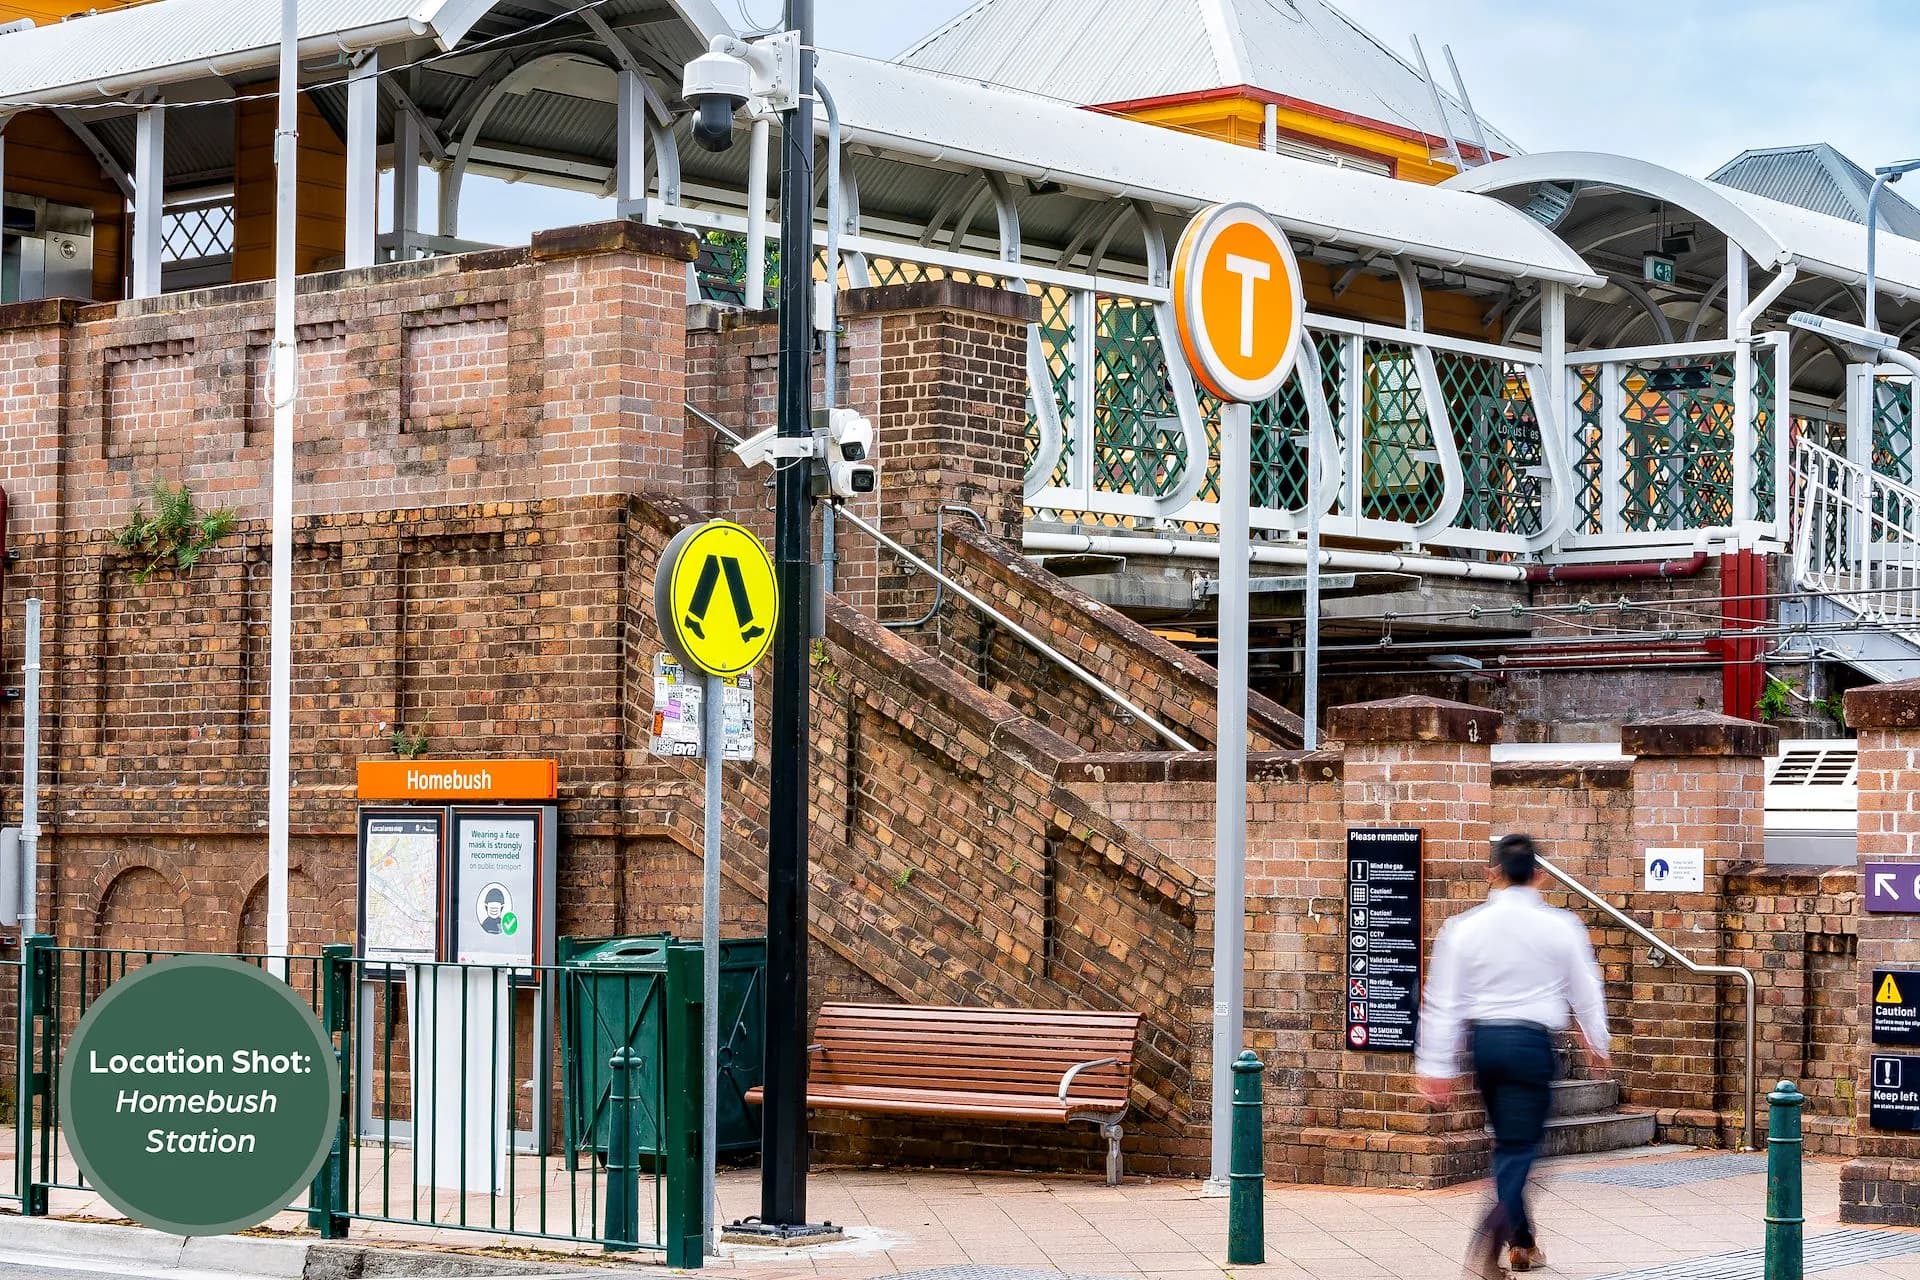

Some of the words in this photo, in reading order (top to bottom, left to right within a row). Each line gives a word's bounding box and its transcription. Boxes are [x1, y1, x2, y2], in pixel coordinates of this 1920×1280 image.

[1226, 253, 1270, 358] T
[407, 769, 492, 790] Homebush
[472, 830, 498, 840] Wearing
[506, 830, 520, 839] face
[1351, 832, 1376, 841] Please
[1377, 832, 1418, 842] remember
[469, 841, 486, 849] mask
[488, 841, 493, 849] is
[495, 842, 522, 851] strongly
[471, 851, 520, 859] recommended
[478, 863, 494, 871] public
[496, 863, 522, 872] transport
[1378, 979, 1393, 987] riding
[1876, 1006, 1916, 1017] Caution!
[1874, 1090, 1899, 1102] Keep
[1900, 1091, 1918, 1102] left
